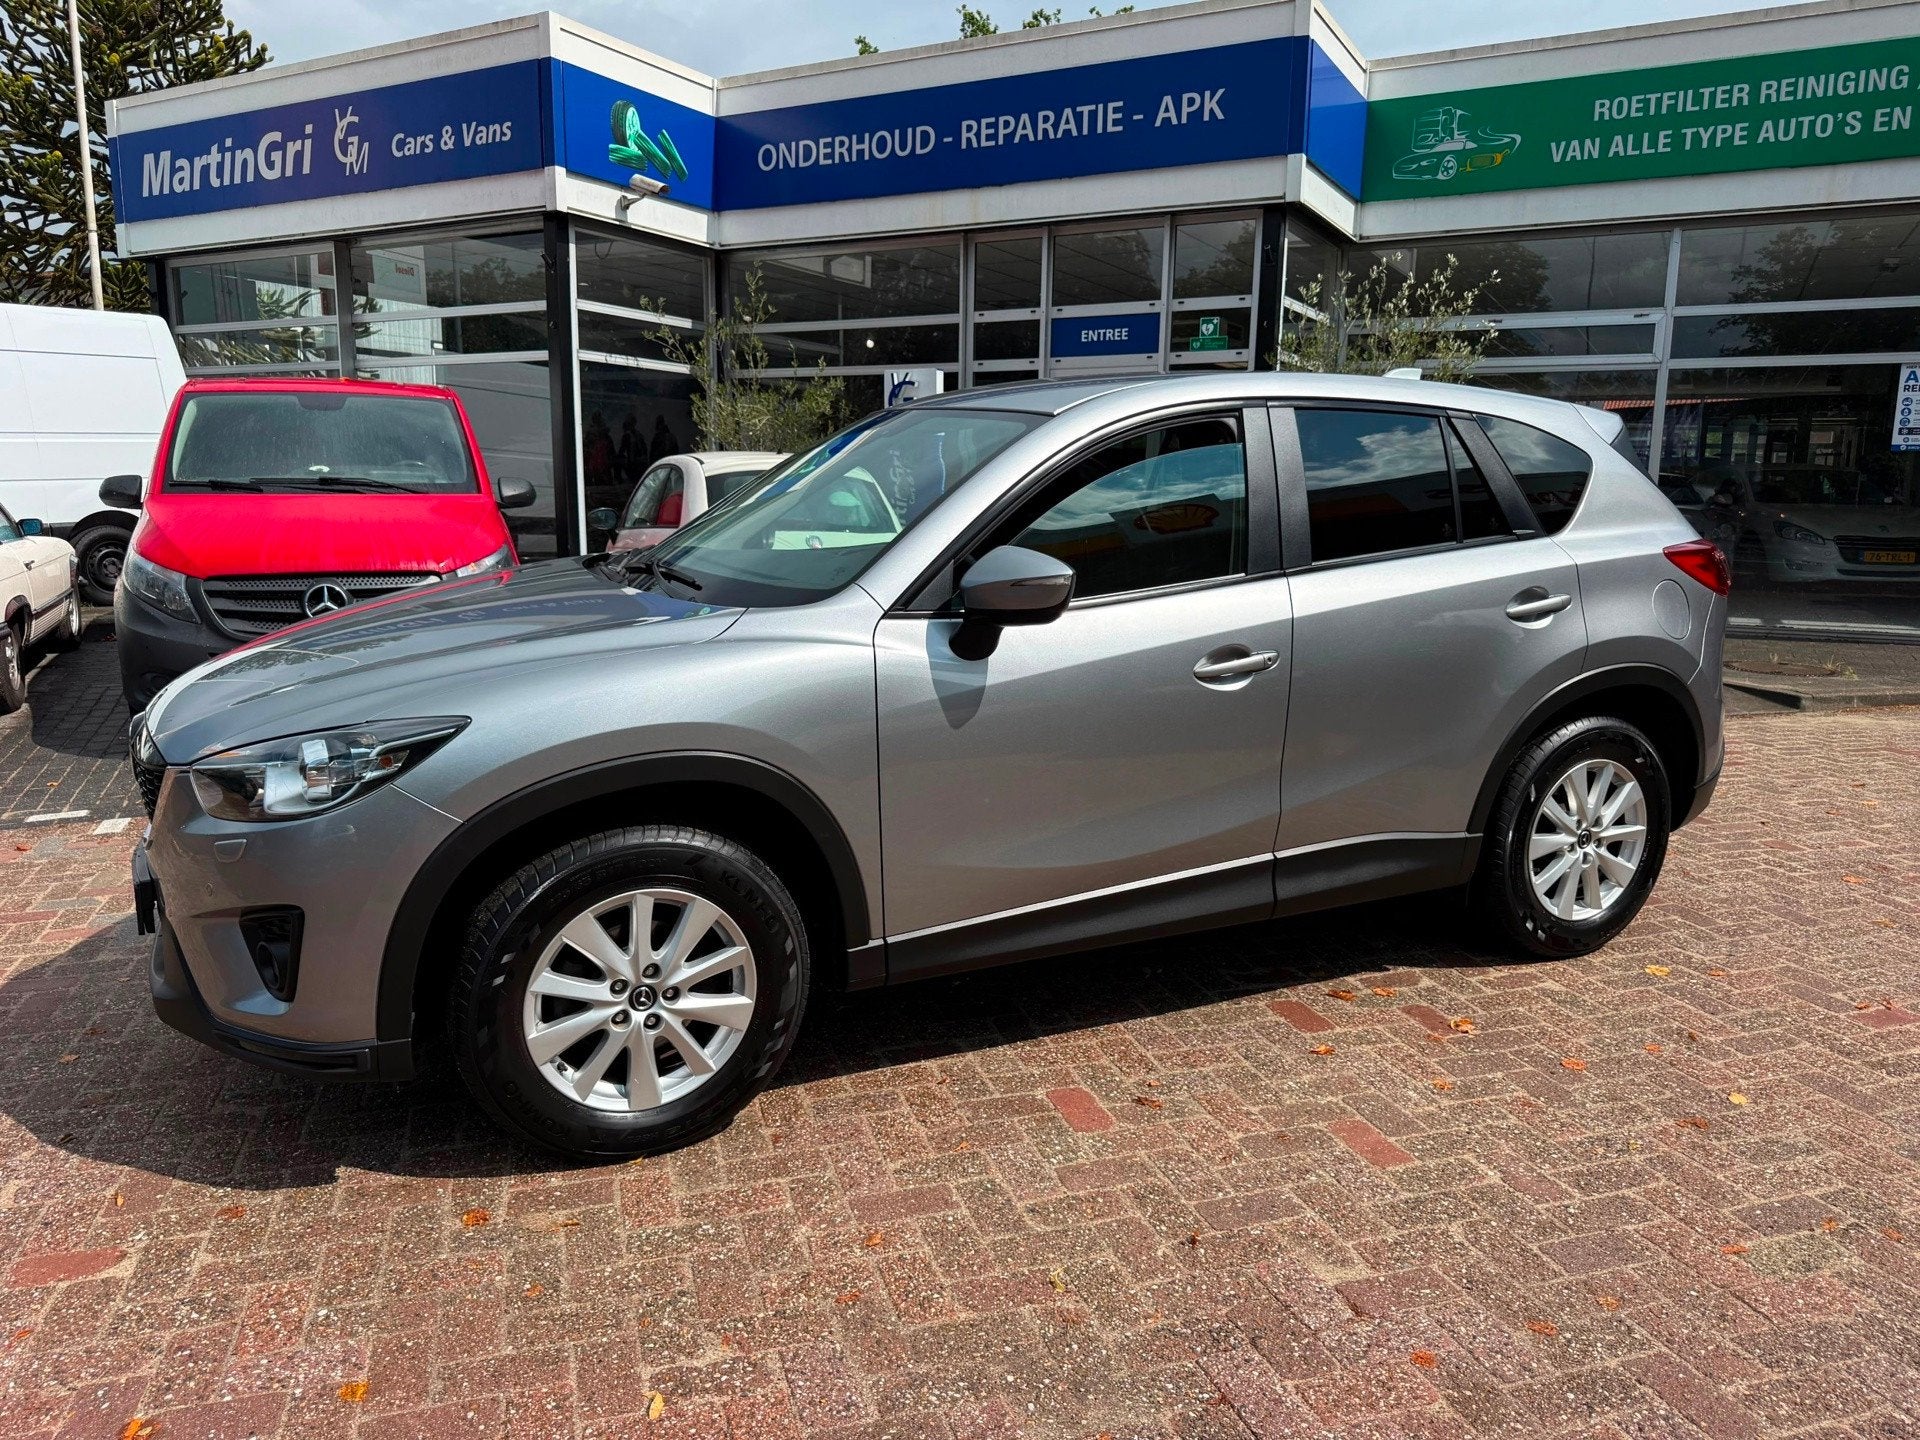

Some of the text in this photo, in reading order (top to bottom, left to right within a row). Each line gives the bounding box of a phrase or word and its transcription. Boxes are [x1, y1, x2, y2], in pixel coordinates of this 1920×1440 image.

[1594, 64, 1910, 122] ROETFILTER REINIGING
[757, 125, 936, 172] ONDERHOUD
[961, 101, 1124, 149] REPARATIE
[1154, 88, 1226, 127] APK
[1550, 105, 1912, 163] VAN ALLE TYPE AUTO'S EN
[142, 124, 313, 198] MartinGri
[391, 132, 434, 158] Cars
[440, 125, 455, 150] &
[462, 121, 512, 147] Vans
[1081, 328, 1129, 342] ENTREE
